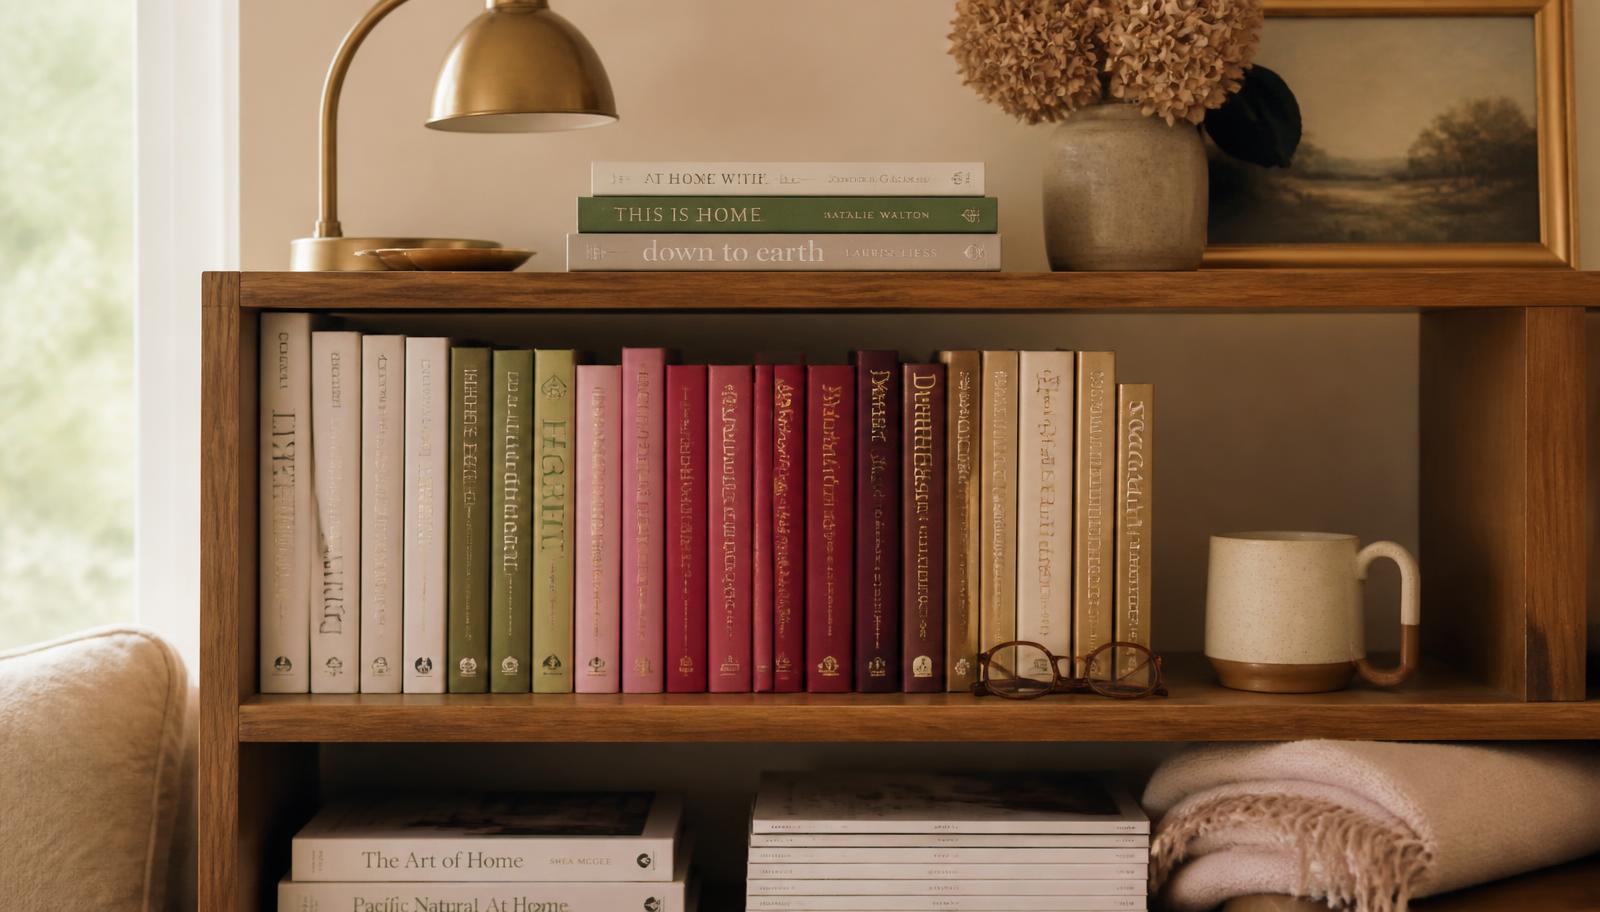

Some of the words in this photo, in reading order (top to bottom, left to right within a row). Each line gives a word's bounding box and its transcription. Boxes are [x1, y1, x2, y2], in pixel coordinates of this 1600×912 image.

[644, 172, 664, 184] AT
[614, 207, 663, 222] THIS
[671, 207, 689, 222] IS
[696, 207, 763, 222] HOME
[880, 211, 930, 219] WALTON
[643, 239, 715, 262] down
[722, 243, 748, 262] to
[756, 239, 824, 262] earth
[361, 851, 399, 868] The
[405, 851, 436, 868] Art
[442, 851, 463, 868] of
[468, 851, 523, 868] Home
[485, 897, 508, 912] At
